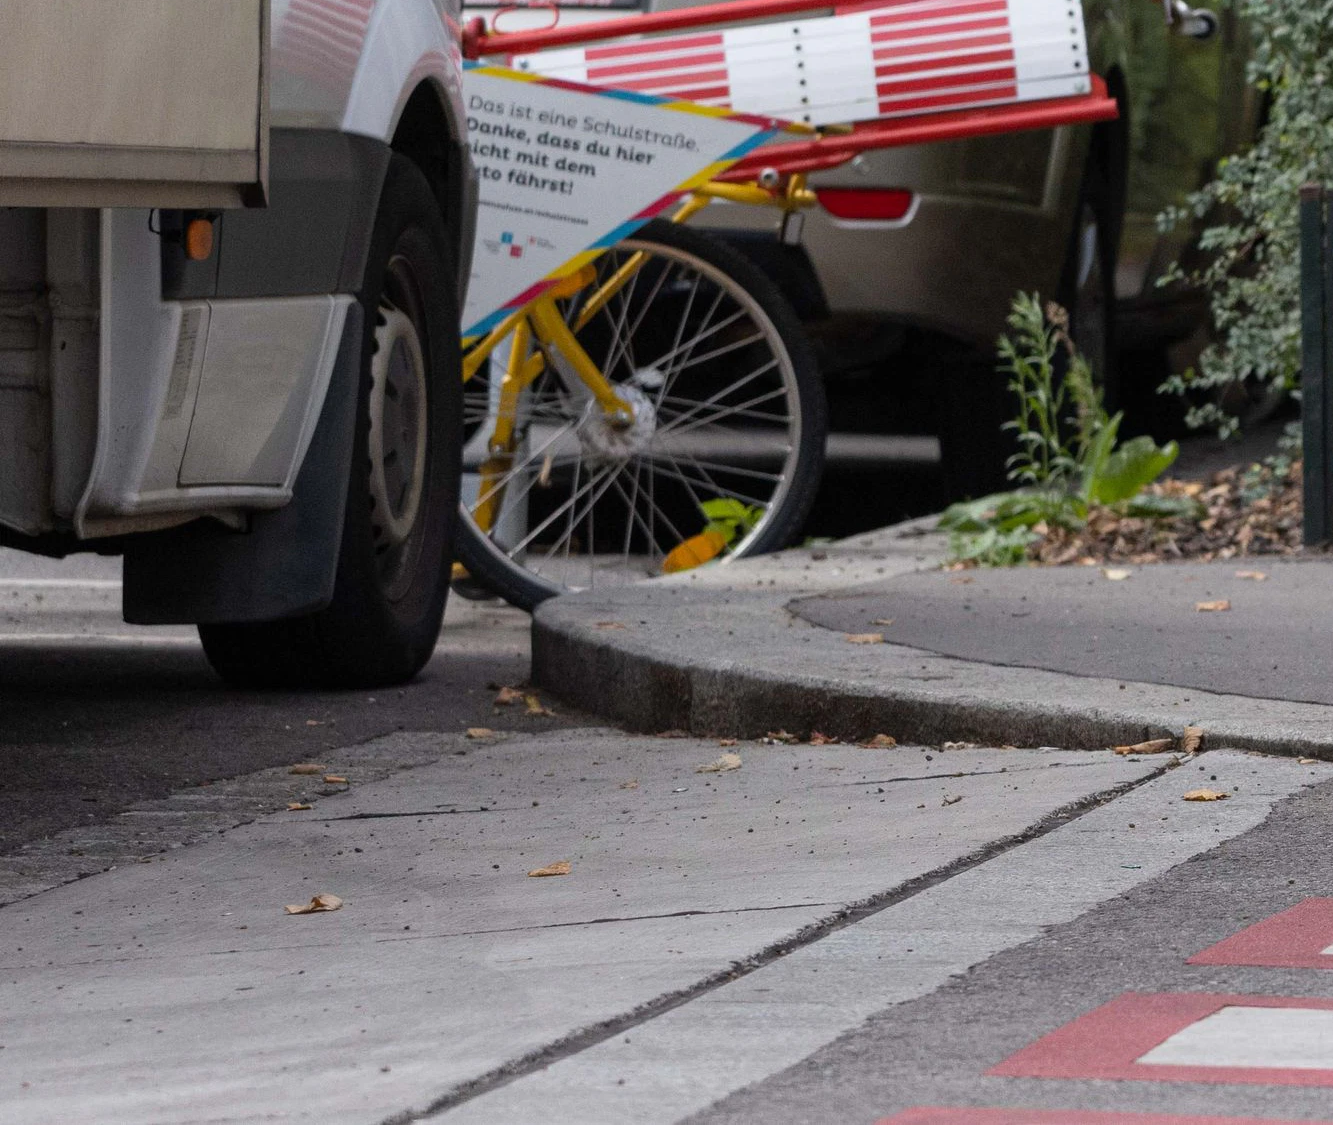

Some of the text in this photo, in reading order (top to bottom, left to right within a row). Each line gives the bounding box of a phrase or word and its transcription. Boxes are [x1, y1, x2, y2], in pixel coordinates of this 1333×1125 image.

[469, 95, 504, 115] Das
[510, 102, 532, 120] ist
[538, 108, 578, 130] eine
[467, 116, 657, 167] Danke, dass du hier
[516, 151, 549, 169] mit
[554, 156, 596, 177] dem
[508, 167, 574, 196] fährst!
